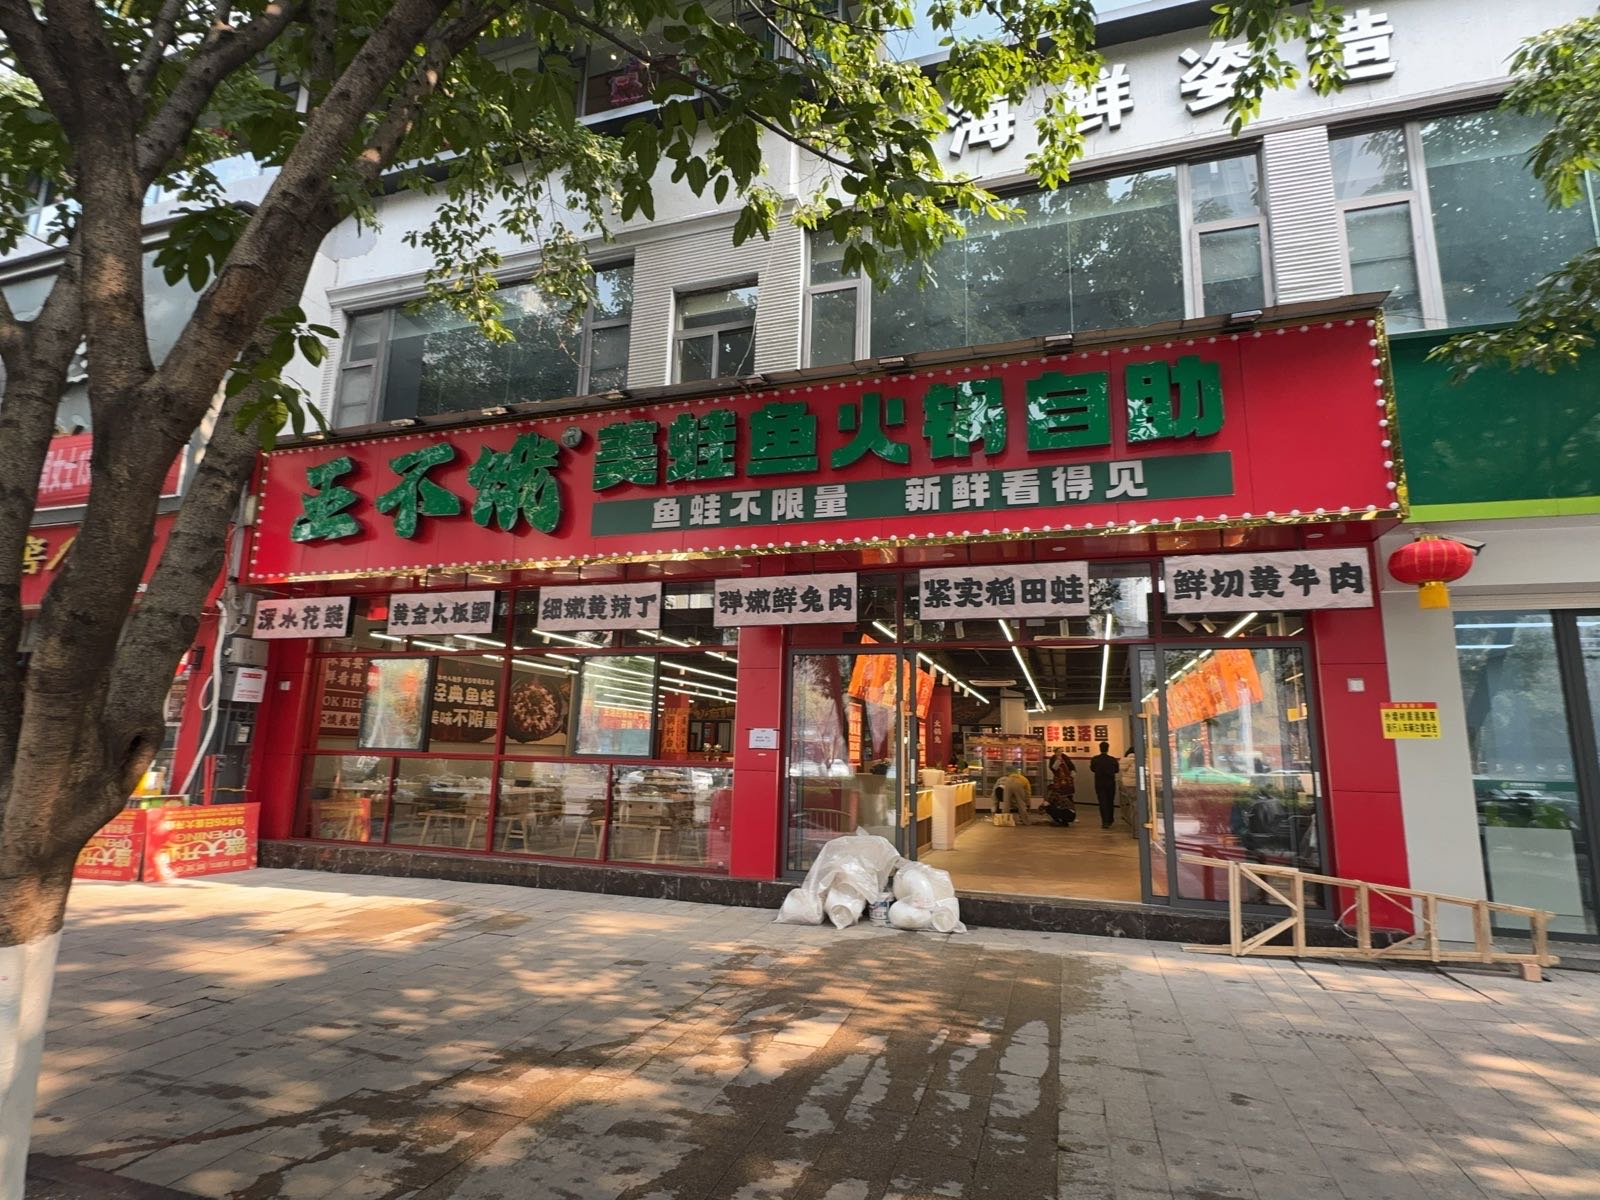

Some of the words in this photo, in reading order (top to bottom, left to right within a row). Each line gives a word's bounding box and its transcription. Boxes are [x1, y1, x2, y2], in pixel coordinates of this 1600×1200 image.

[593, 355, 1225, 491] 美蛙鱼火锅自助
[651, 484, 848, 529] 鱼蛙不限量
[904, 460, 1149, 512] 新鲜看得见
[923, 574, 1085, 609] 紧实稻田蛙
[1172, 561, 1365, 600] 鲜切黄牛肉
[391, 601, 491, 626] 黄金大板鲫
[541, 594, 657, 620] 细嫩黄辣丁
[719, 583, 853, 615] 弹嫩鲜兔肉
